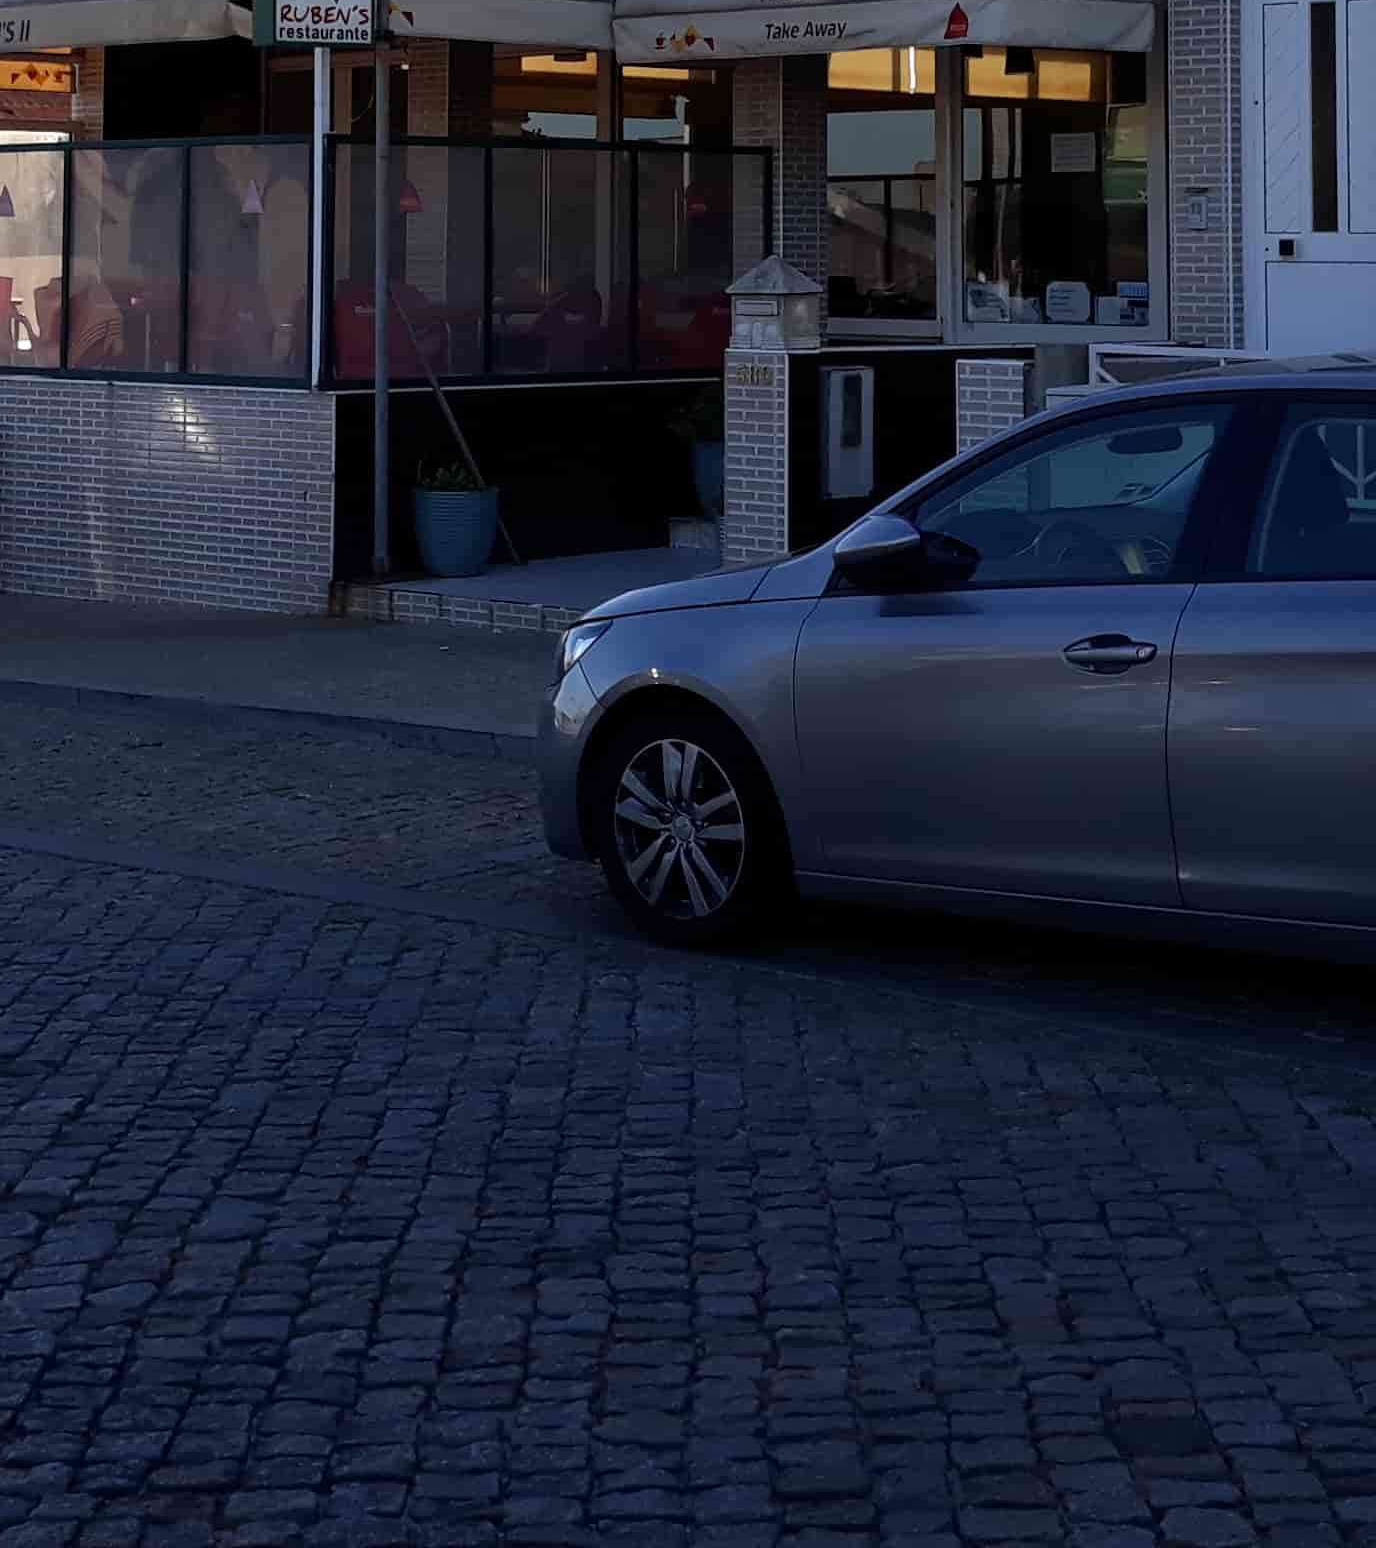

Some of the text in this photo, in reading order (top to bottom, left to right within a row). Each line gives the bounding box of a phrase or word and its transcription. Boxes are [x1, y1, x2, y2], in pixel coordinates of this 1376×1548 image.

[280, 4, 369, 25] RUBEN'S
[20, 19, 31, 42] II
[279, 25, 369, 41] restaurante
[765, 20, 847, 40] Take Away
